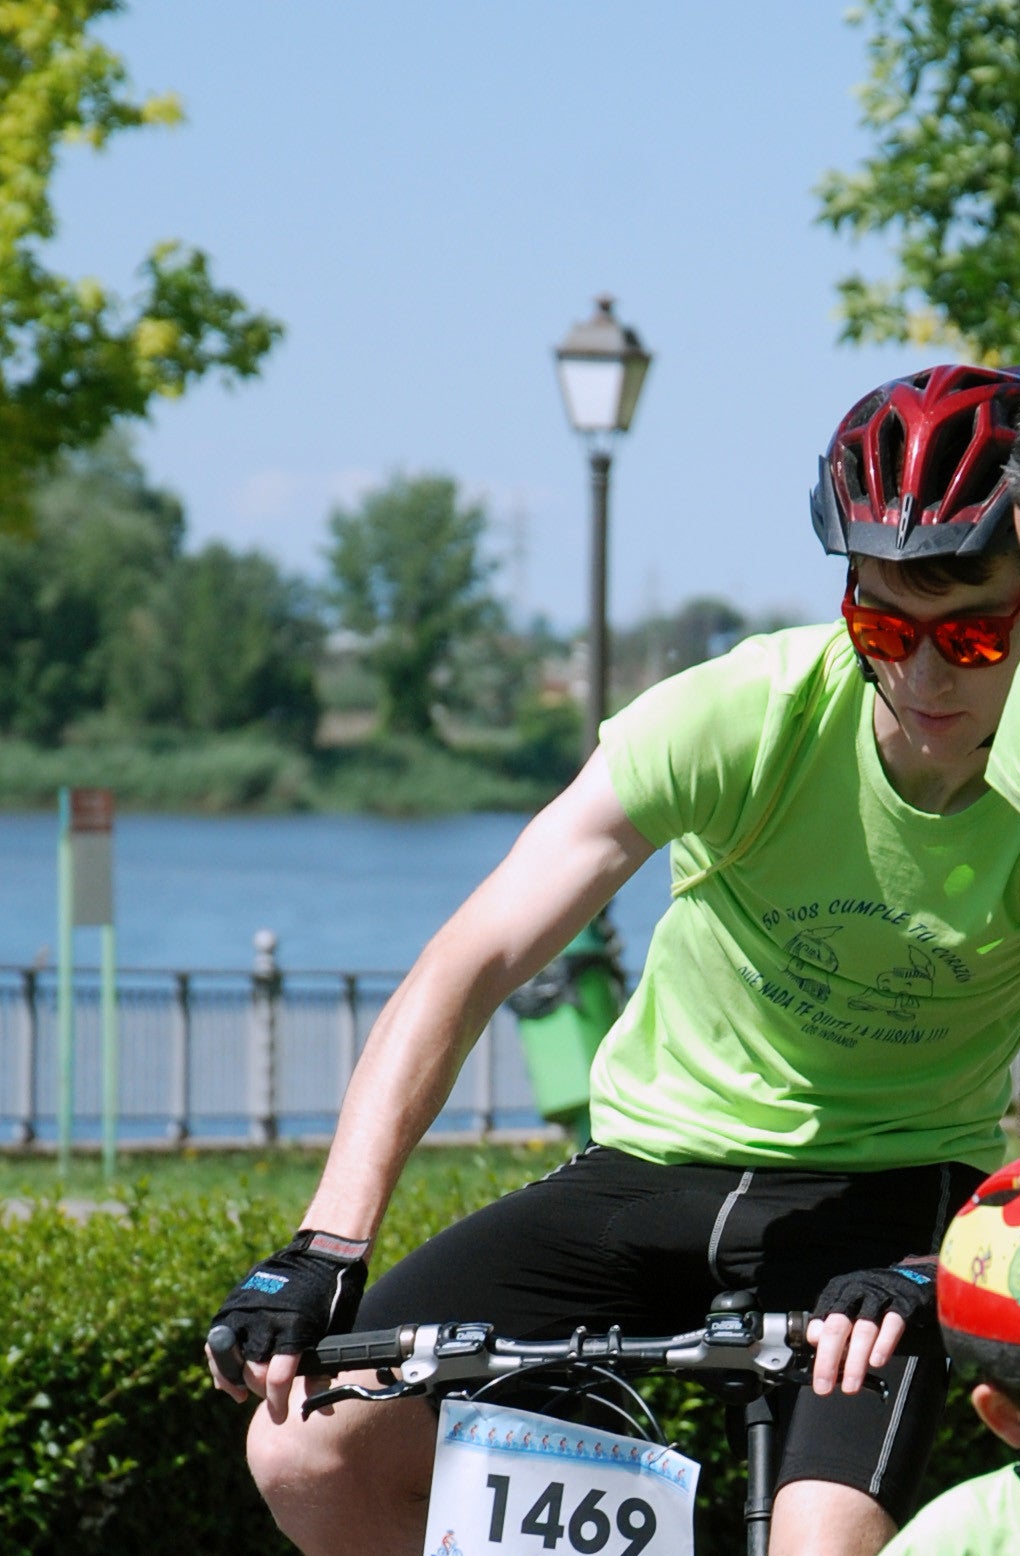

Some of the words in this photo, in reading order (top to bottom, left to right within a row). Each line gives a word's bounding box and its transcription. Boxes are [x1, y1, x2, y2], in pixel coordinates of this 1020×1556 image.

[828, 899, 910, 926] CUMPLE
[909, 922, 936, 944] TU
[758, 981, 795, 1010] NADA
[794, 1001, 815, 1016] TE
